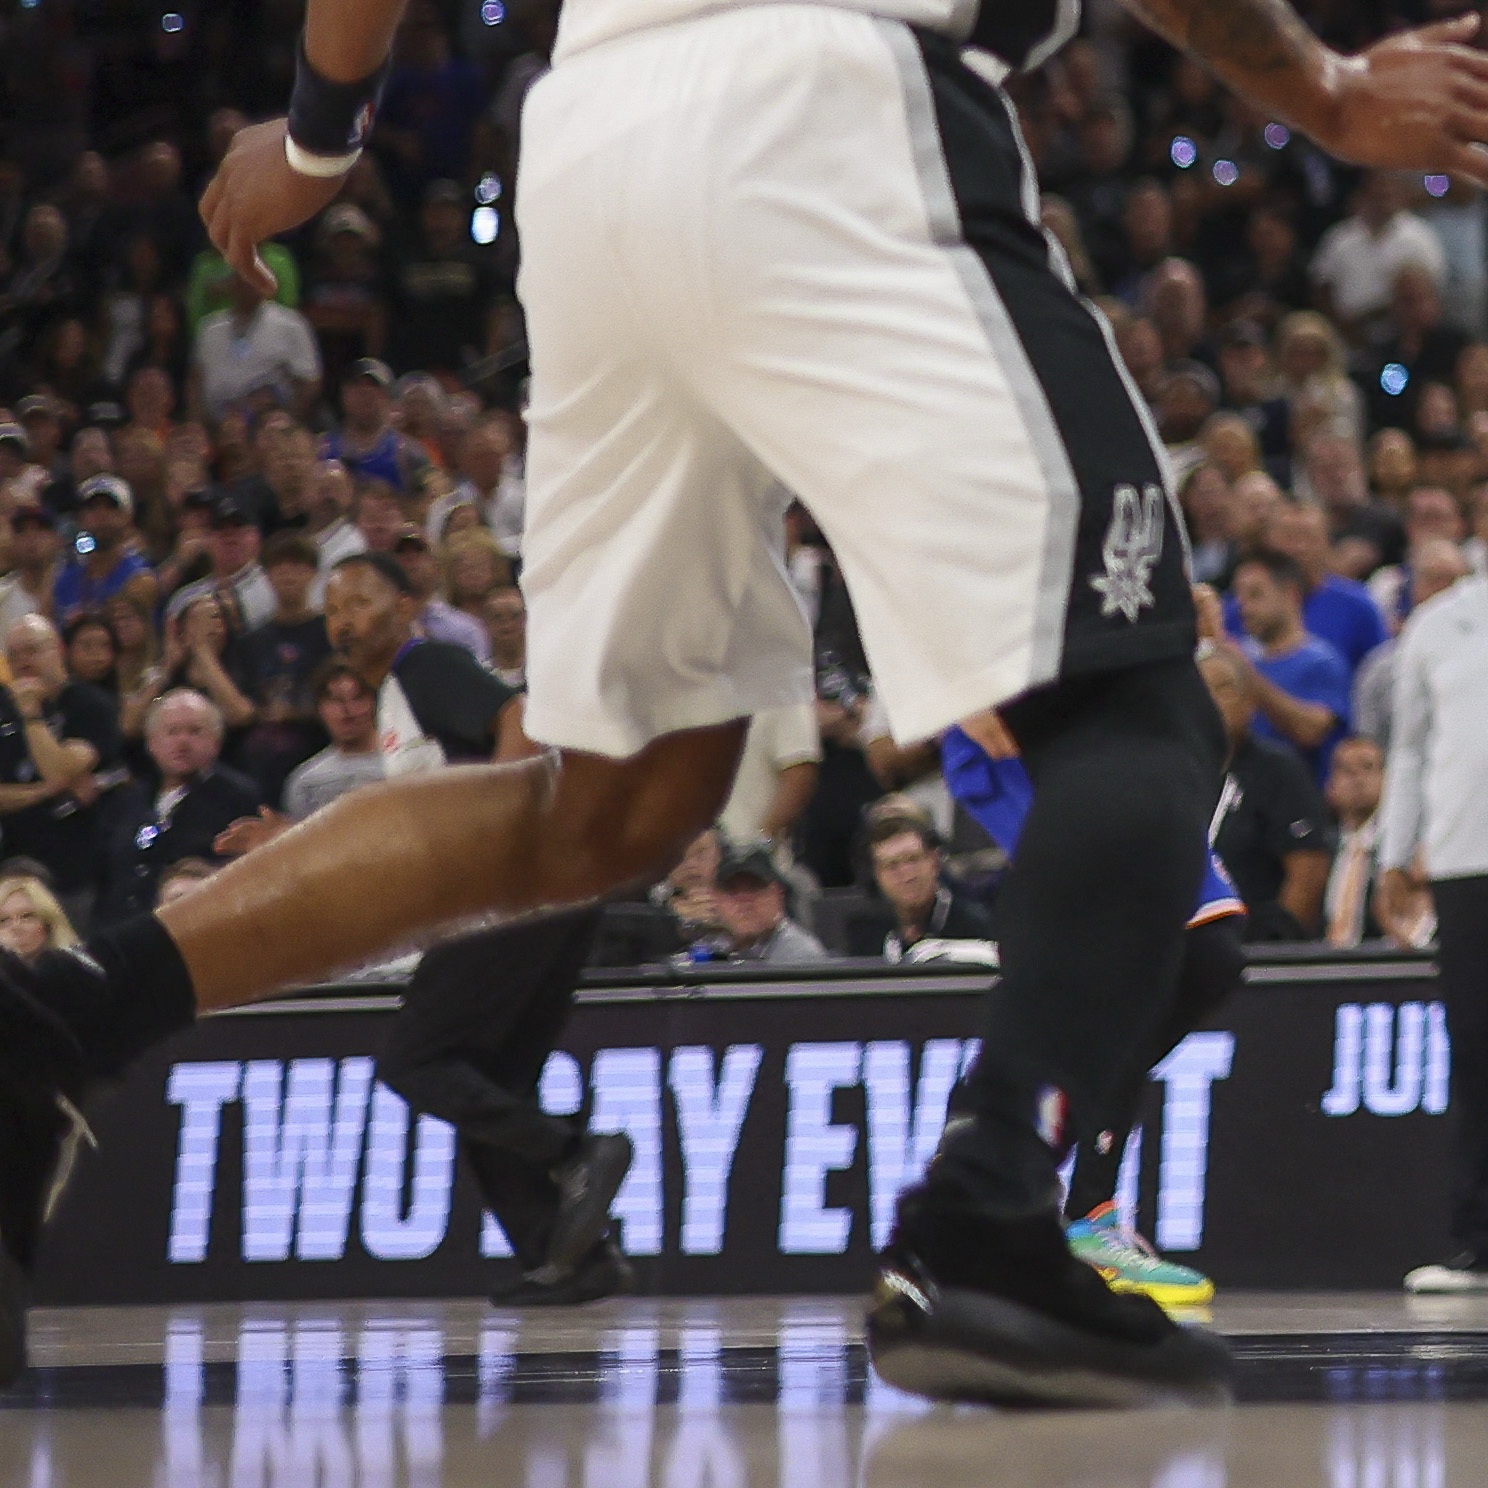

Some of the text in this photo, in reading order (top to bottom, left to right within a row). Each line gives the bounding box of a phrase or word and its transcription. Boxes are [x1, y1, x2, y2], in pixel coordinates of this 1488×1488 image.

[165, 1030, 1237, 1263] TWO AY EVT
